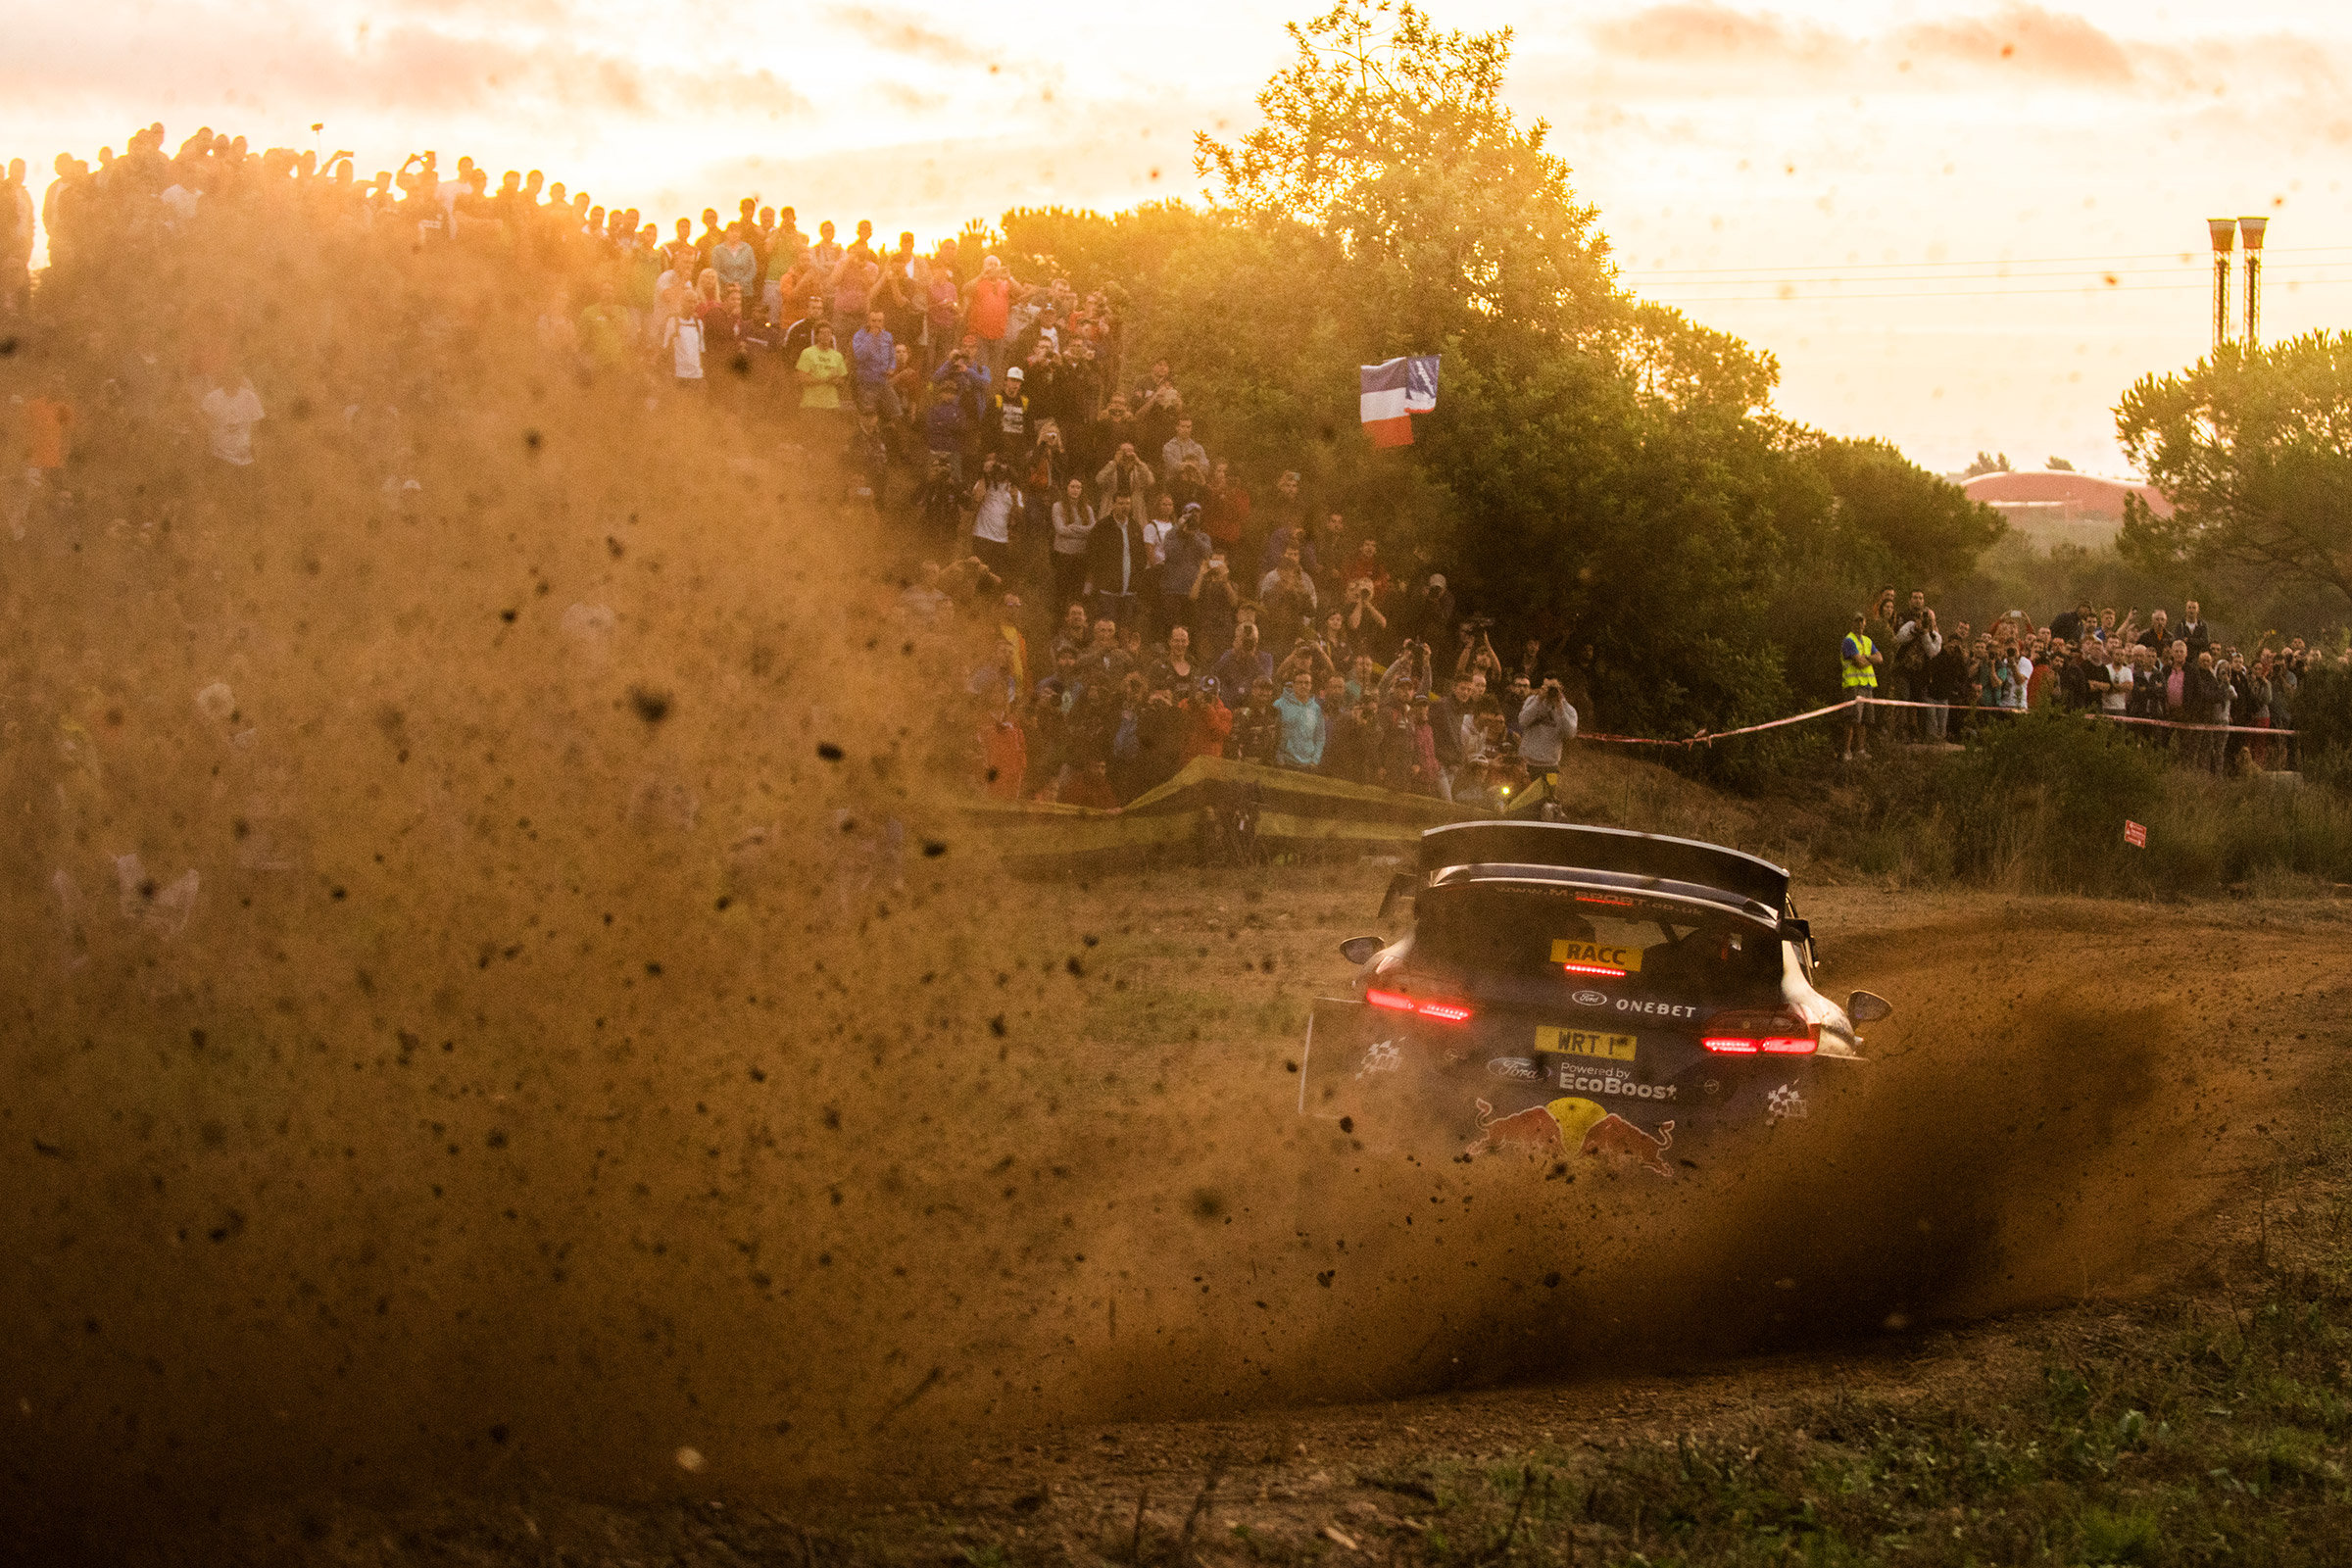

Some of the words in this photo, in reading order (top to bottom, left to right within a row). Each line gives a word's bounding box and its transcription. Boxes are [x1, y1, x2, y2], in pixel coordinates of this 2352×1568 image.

[1566, 943, 1627, 966] RACC
[1615, 999, 1696, 1018] ONEBET
[1557, 1031, 1601, 1054] WRT
[1560, 1061, 1614, 1078] Powered
[1616, 1068, 1631, 1080] by
[1559, 1072, 1677, 1100] EcoBoost
